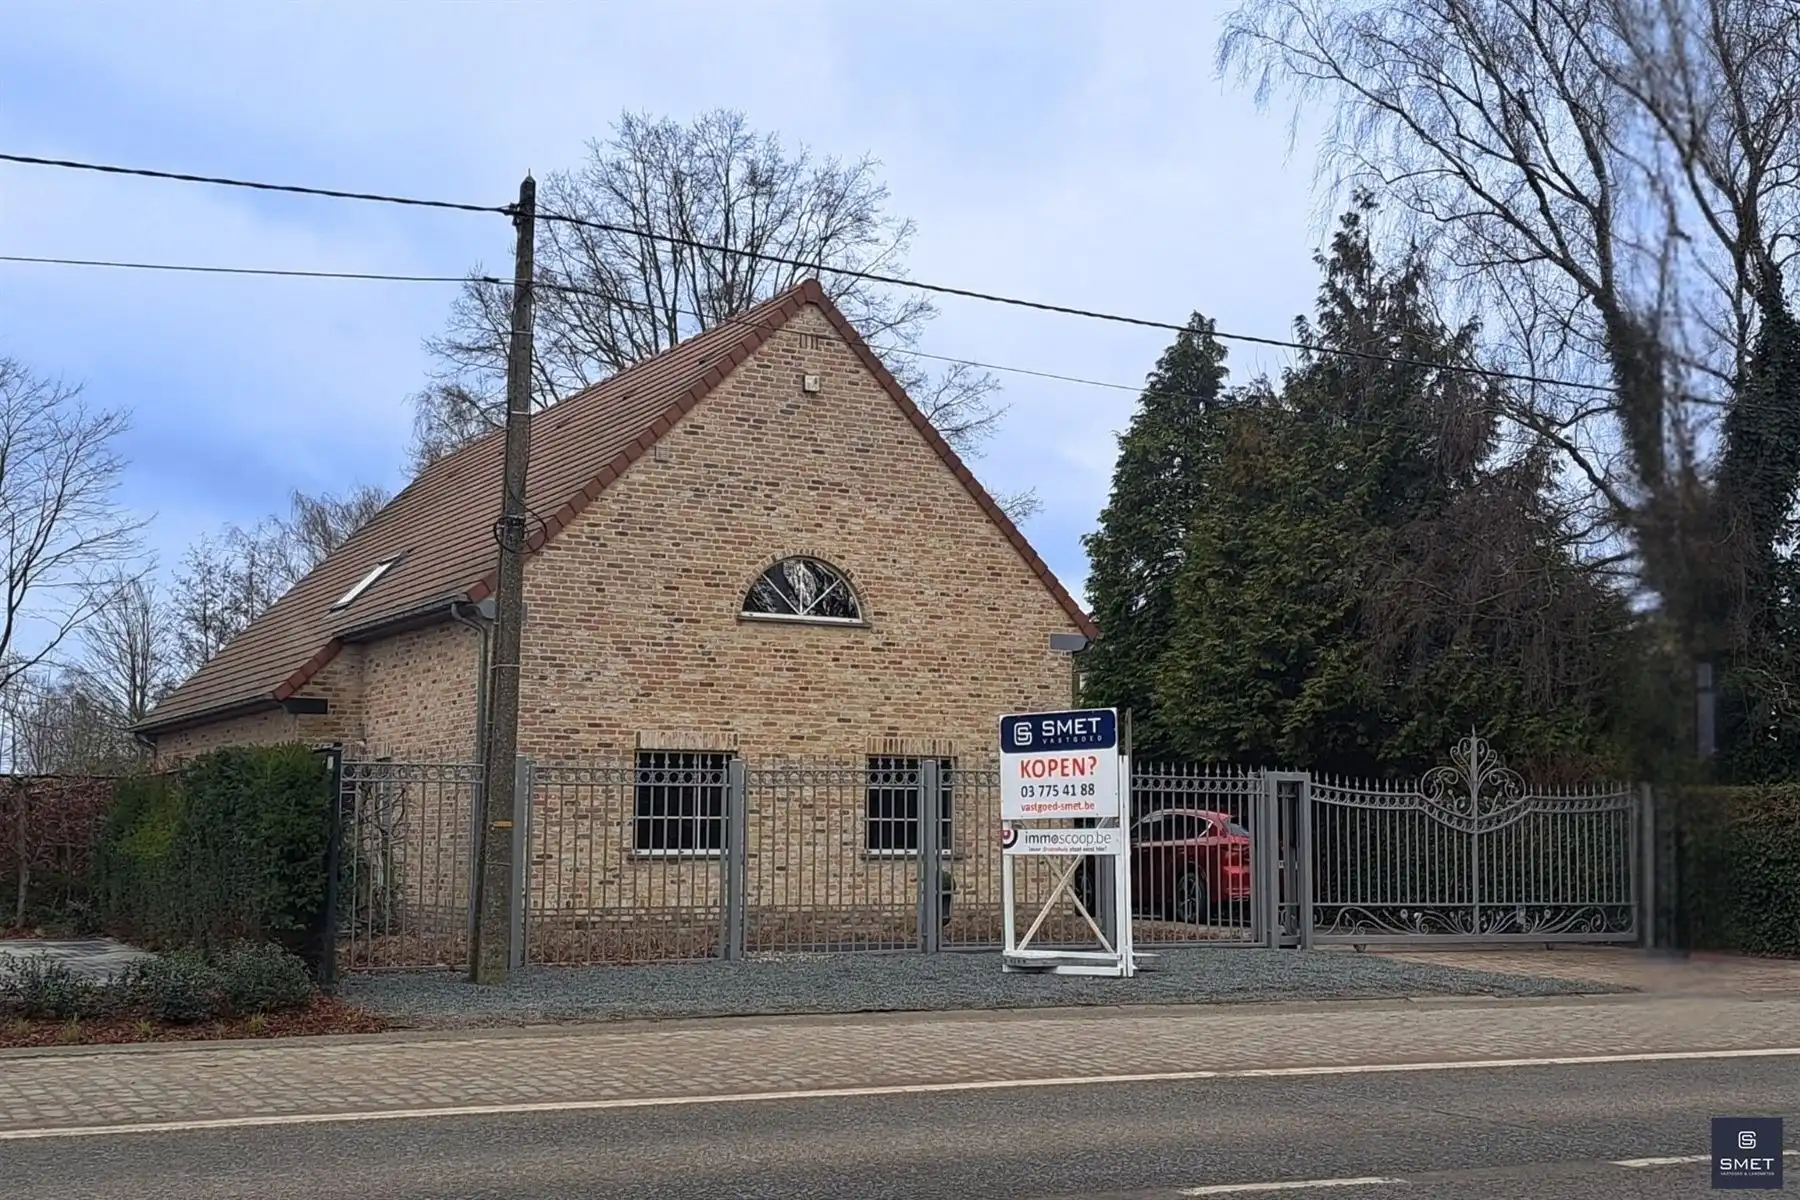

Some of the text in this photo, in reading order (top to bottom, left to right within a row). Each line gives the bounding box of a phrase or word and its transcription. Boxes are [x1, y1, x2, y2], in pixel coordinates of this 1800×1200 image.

[1042, 717, 1101, 736] SMET
[1042, 735, 1103, 745] VASTGOED
[1020, 756, 1098, 779] KOPEN?
[1020, 783, 1095, 798] 03 775 41 88
[1021, 801, 1095, 813] vastgoed-smet.be
[1025, 832, 1112, 846] immoscoop.be
